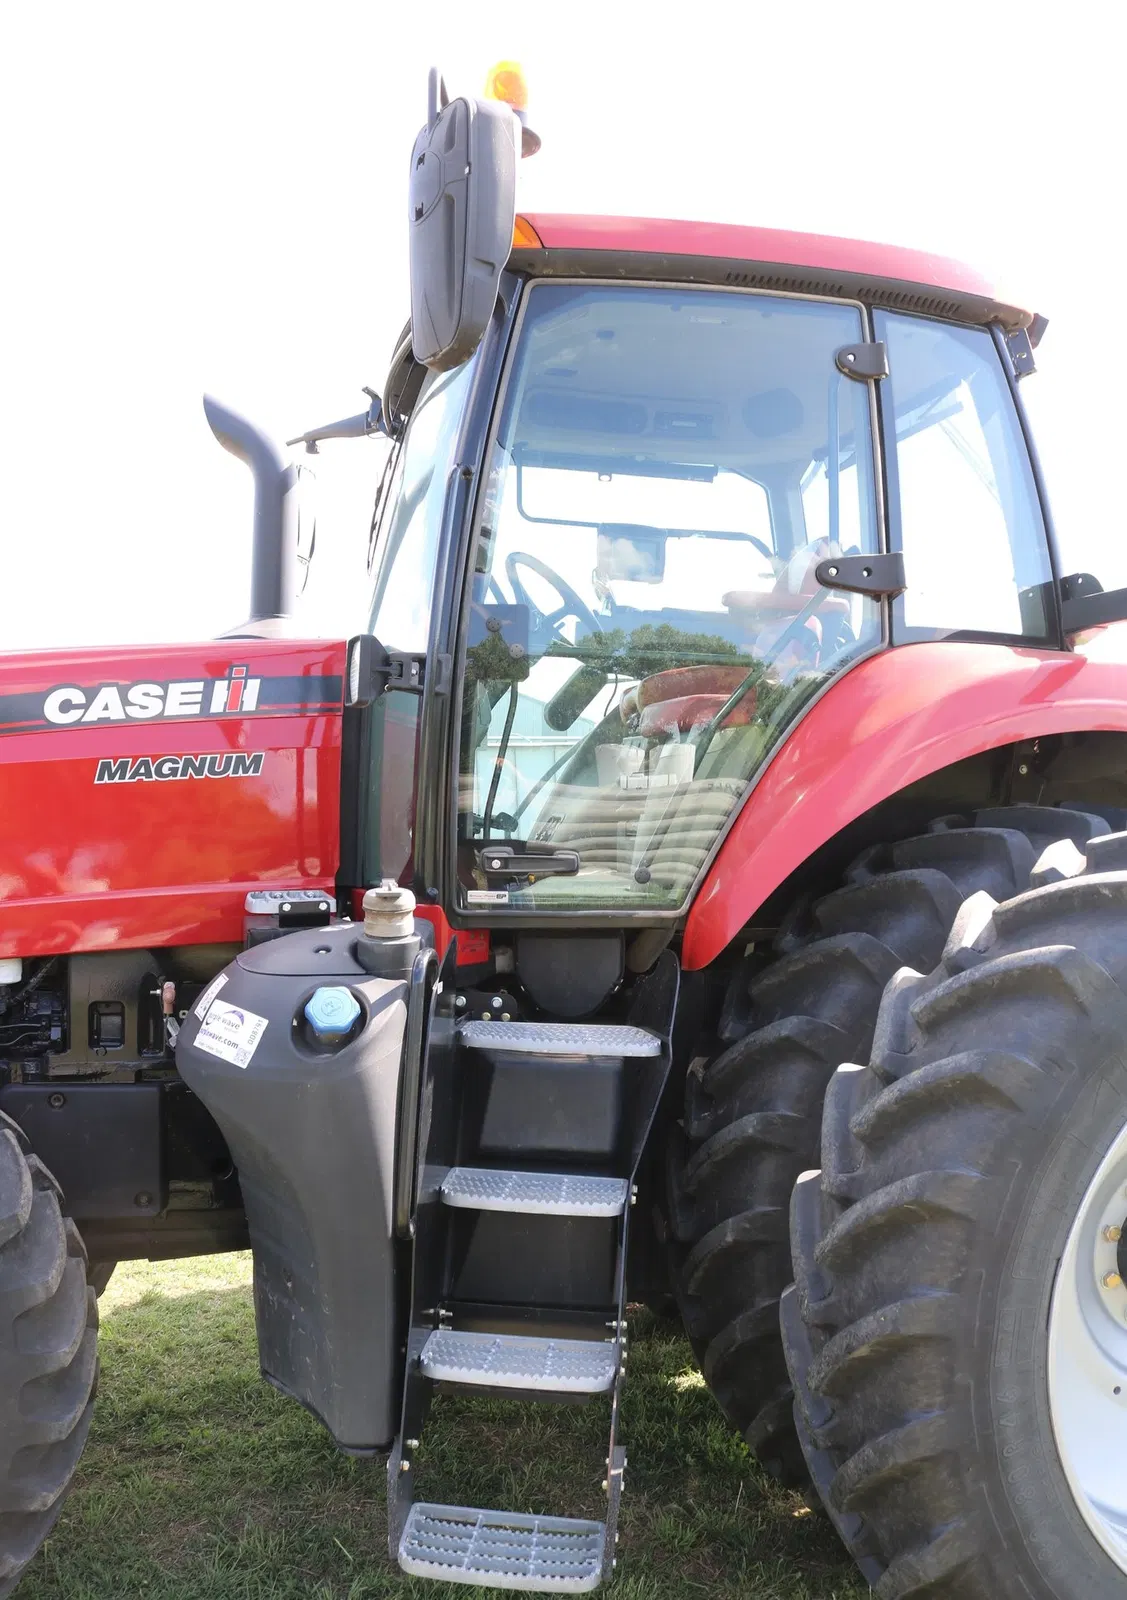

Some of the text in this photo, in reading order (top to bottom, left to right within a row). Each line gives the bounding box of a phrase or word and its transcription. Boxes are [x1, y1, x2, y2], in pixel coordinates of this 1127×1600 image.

[43, 681, 204, 724] CASE
[94, 752, 264, 784] MAGNUM
[222, 1017, 240, 1030] wave
